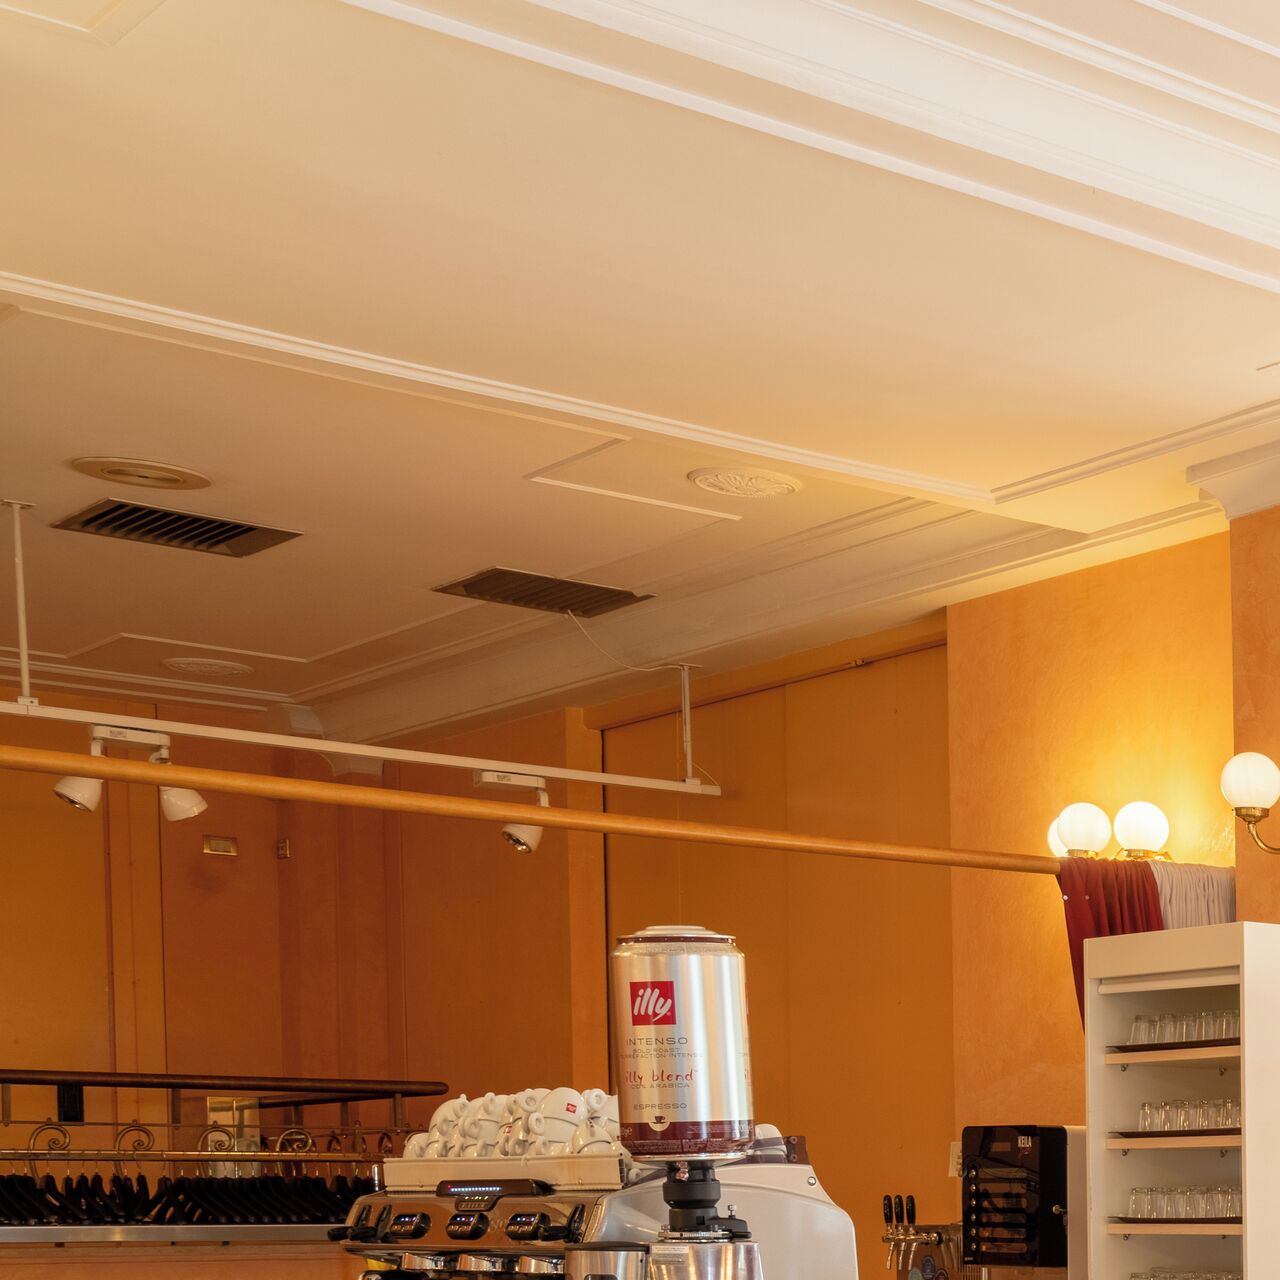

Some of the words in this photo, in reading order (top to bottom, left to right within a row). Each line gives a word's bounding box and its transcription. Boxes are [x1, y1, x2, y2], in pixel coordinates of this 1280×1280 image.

[633, 987, 672, 1022] illy
[626, 1037, 688, 1046] INTENSO
[625, 1071, 643, 1084] illy
[651, 1069, 694, 1081] blend
[633, 1102, 687, 1110] ESPRESSO
